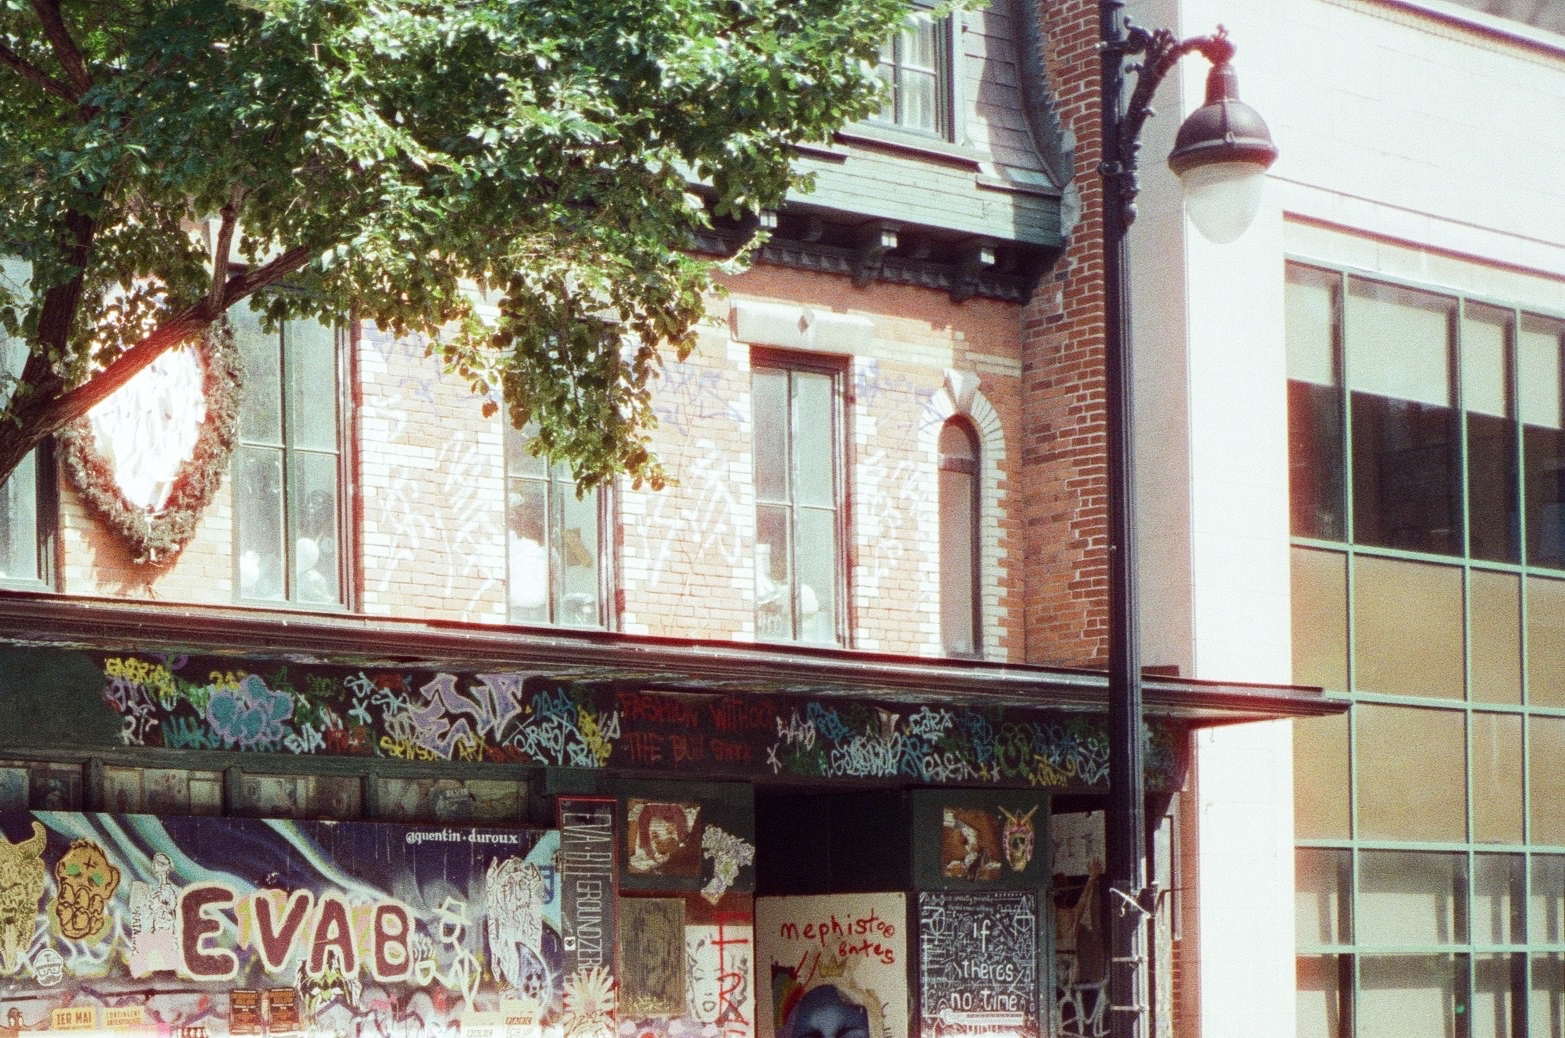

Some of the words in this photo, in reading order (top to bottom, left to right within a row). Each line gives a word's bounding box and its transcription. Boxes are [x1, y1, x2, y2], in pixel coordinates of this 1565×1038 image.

[178, 879, 415, 981] EVAB
[951, 992, 973, 1010] no
[980, 988, 1018, 1011] time
[75, 1011, 92, 1024] MAI
